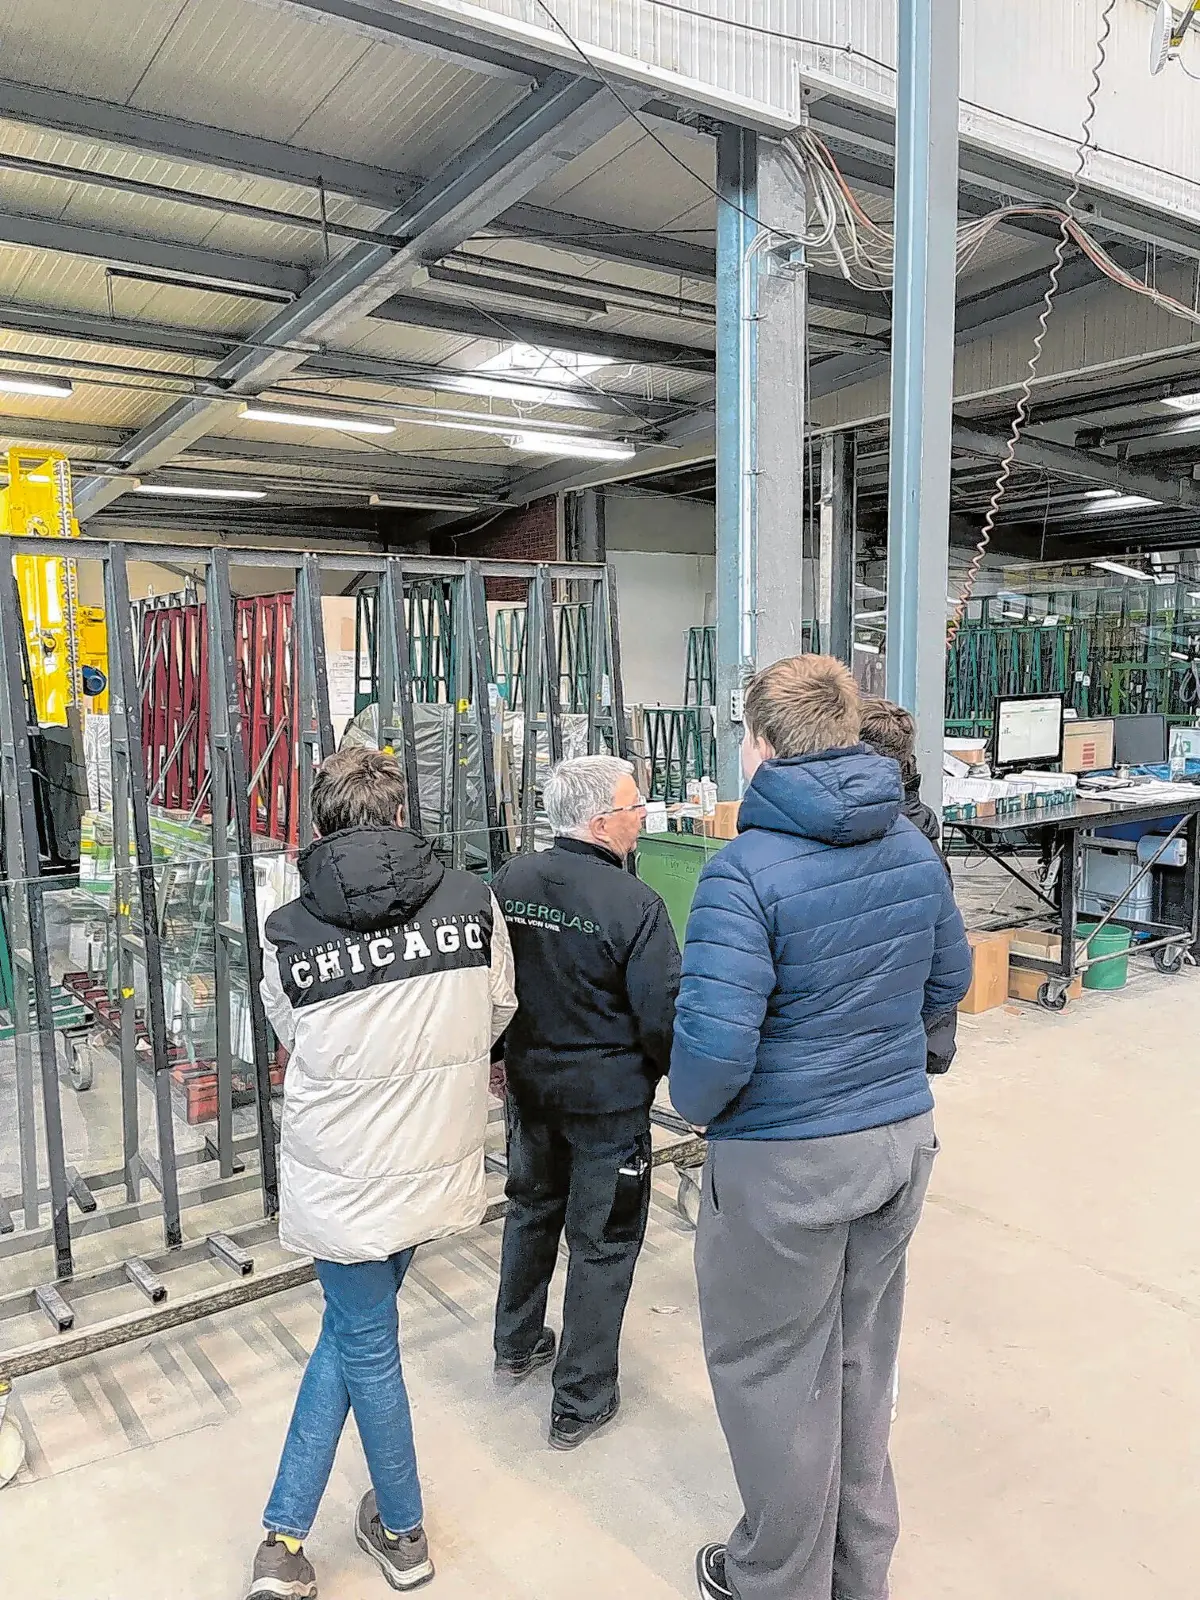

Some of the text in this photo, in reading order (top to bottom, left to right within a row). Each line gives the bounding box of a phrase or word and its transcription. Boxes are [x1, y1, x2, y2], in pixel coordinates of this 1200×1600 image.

[363, 922, 421, 941] UNITED
[528, 919, 543, 928] VON
[291, 923, 483, 989] CHICAGO
